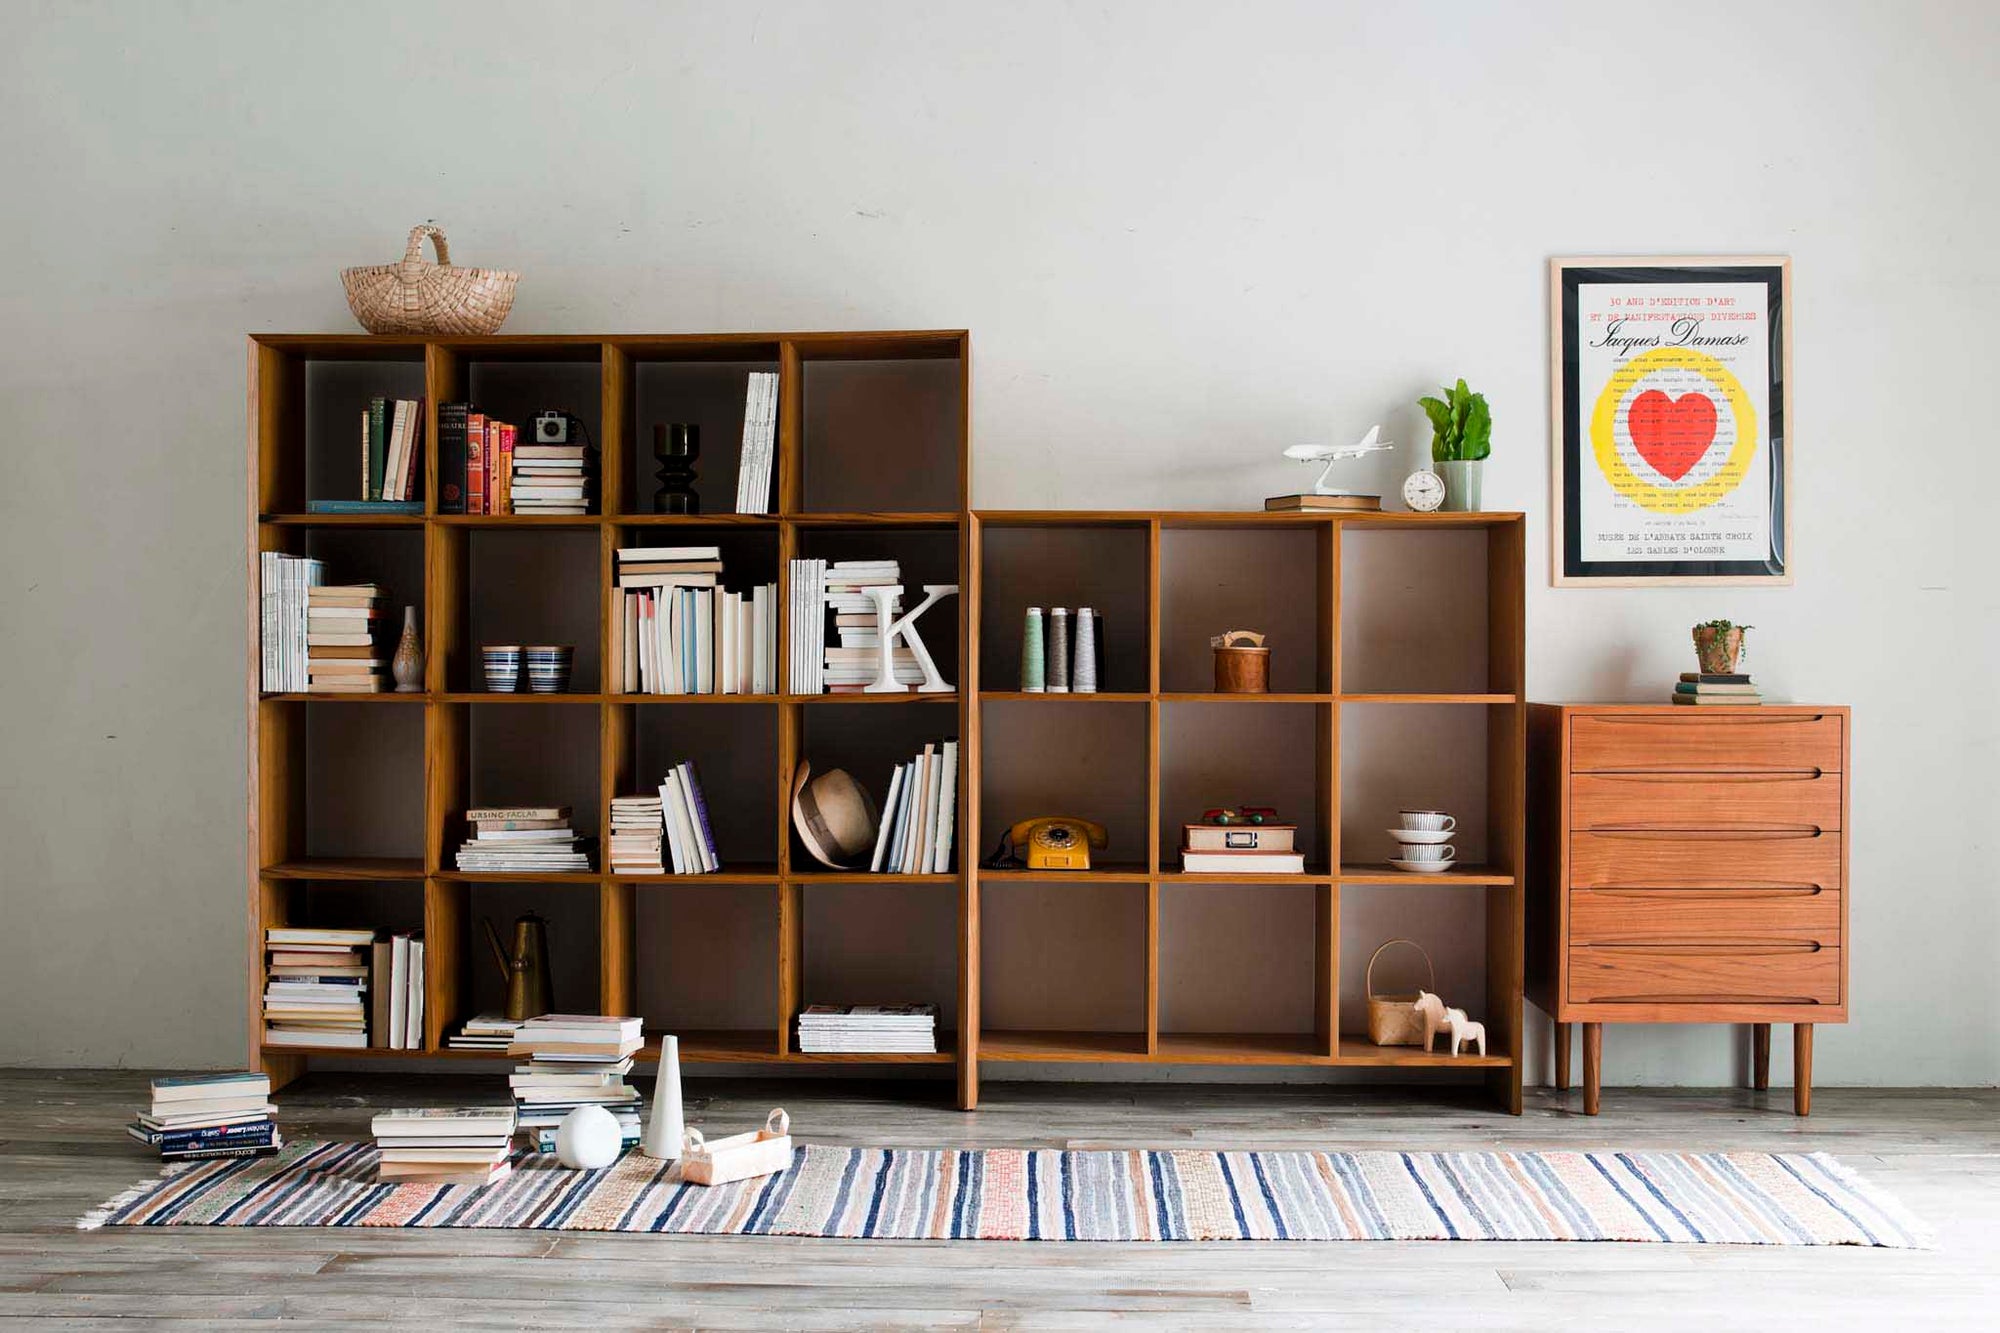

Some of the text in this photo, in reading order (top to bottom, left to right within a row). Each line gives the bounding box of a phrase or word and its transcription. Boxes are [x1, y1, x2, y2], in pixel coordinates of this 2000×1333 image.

[1626, 297, 1644, 306] ANS
[1707, 297, 1736, 306] D'ART
[1589, 313, 1602, 322] ET
[1607, 313, 1620, 322] DE
[1711, 312, 1757, 321] DIVERSES
[1589, 316, 1749, 357] Jacques Damase
[1628, 533, 1640, 541] DE
[1644, 532, 1685, 541] L'ABBAYE
[1689, 532, 1722, 541] SAINTE
[1725, 532, 1753, 540] CROIX
[1626, 546, 1726, 555] LES SABLES D'OLONNE
